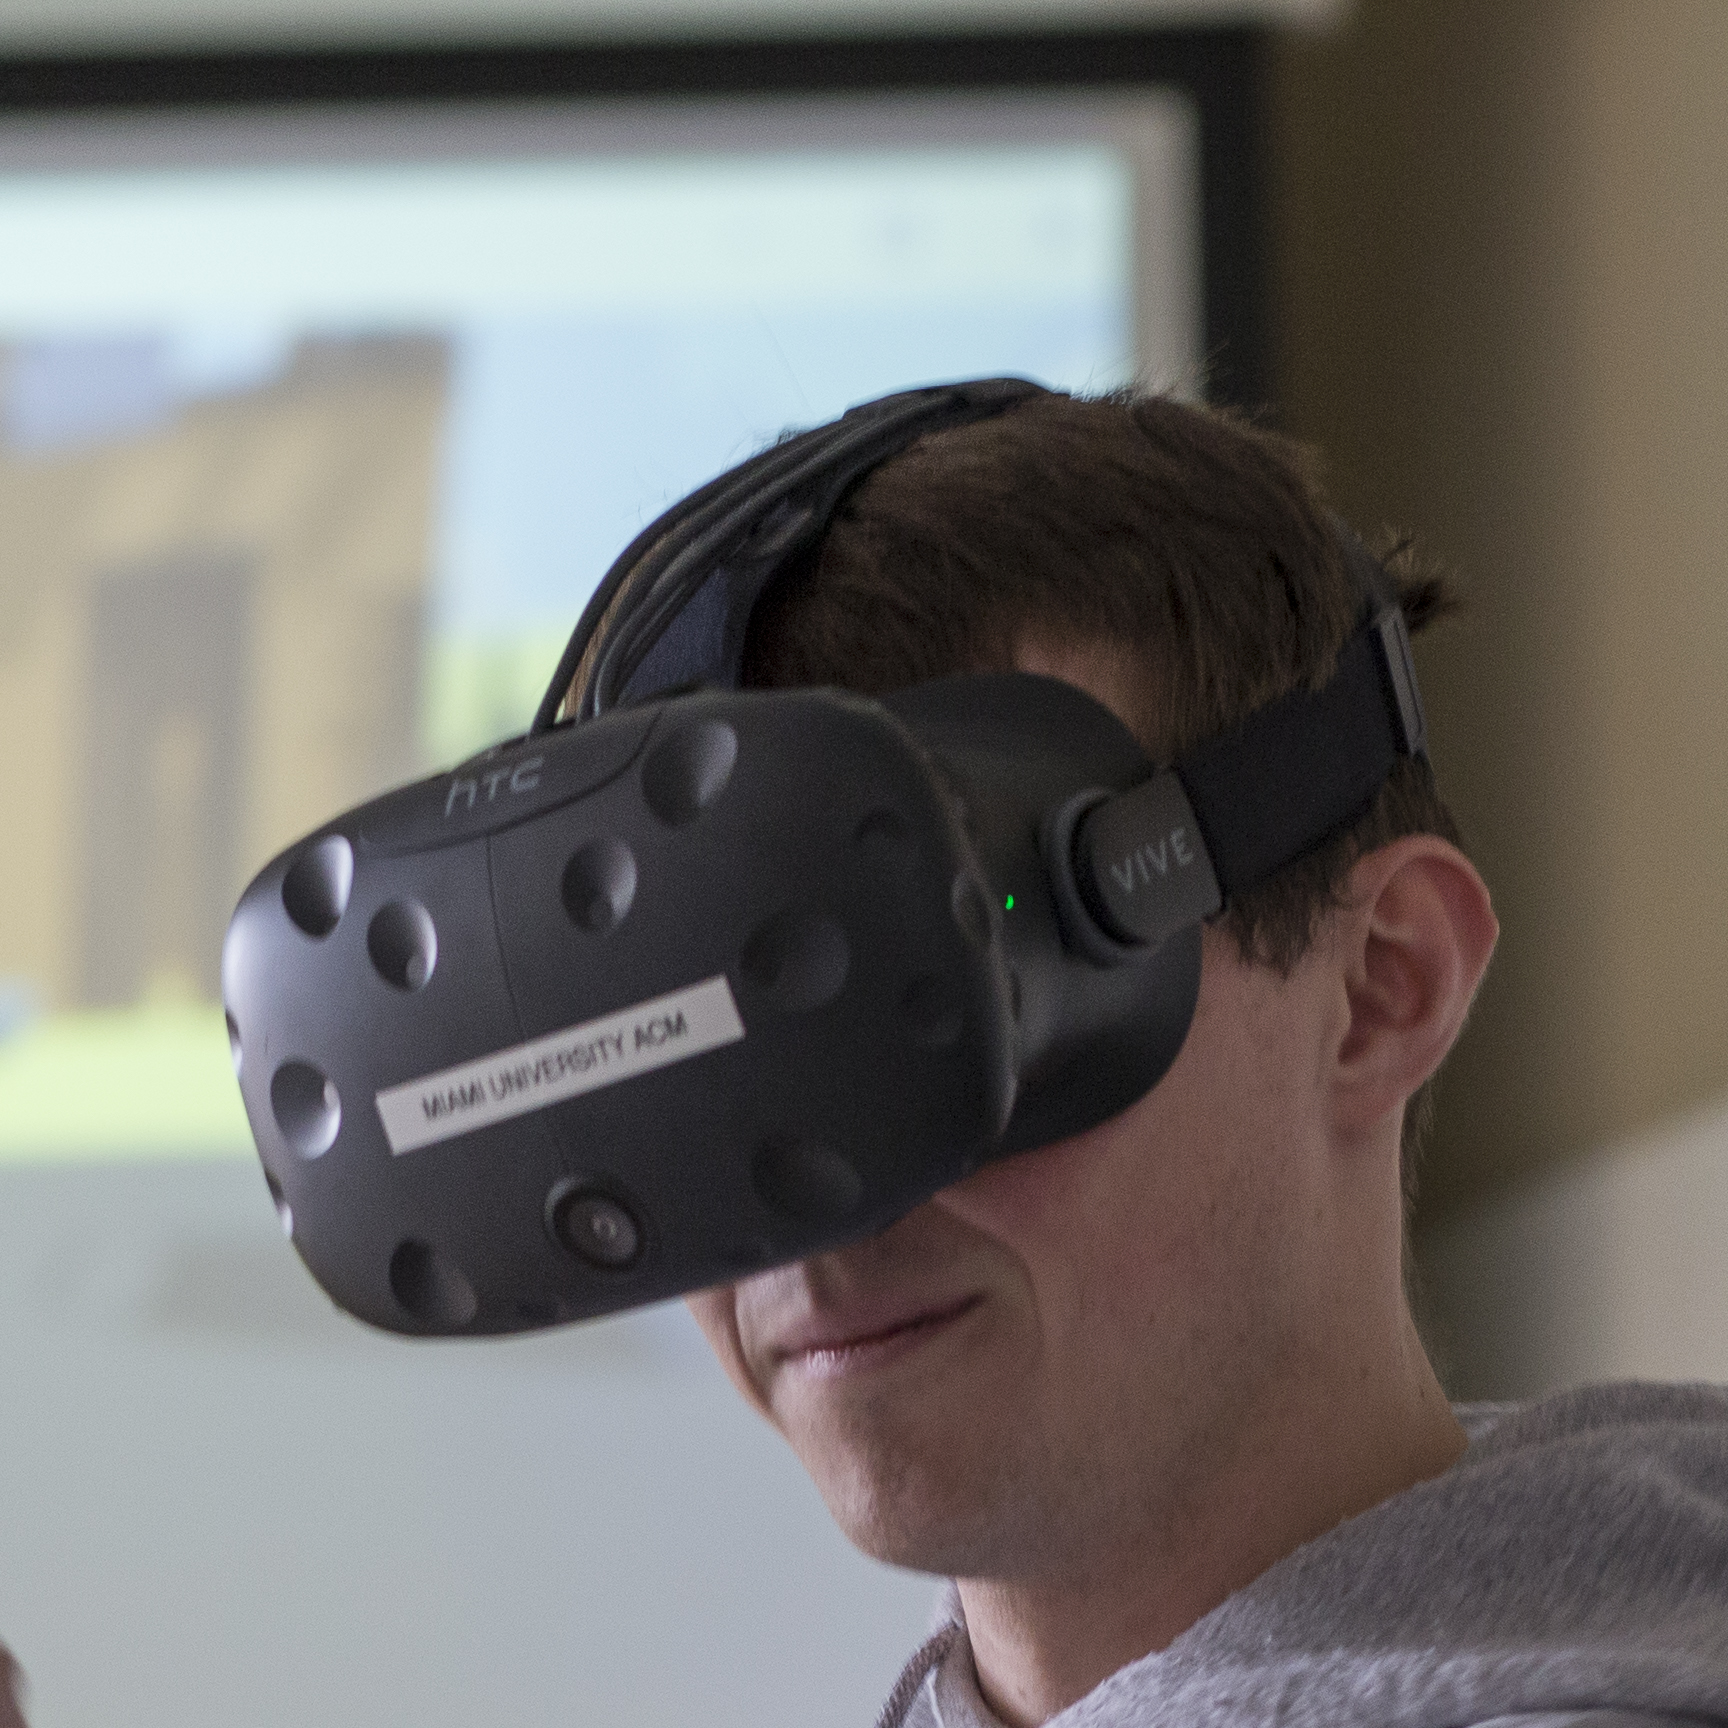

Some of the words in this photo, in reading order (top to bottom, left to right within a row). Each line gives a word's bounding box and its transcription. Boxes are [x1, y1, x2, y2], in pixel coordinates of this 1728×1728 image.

[1111, 827, 1193, 893] VIVE
[421, 1078, 487, 1120] MIAMI
[488, 1029, 623, 1101] UNIVERSITY
[634, 1007, 688, 1051] ACM
